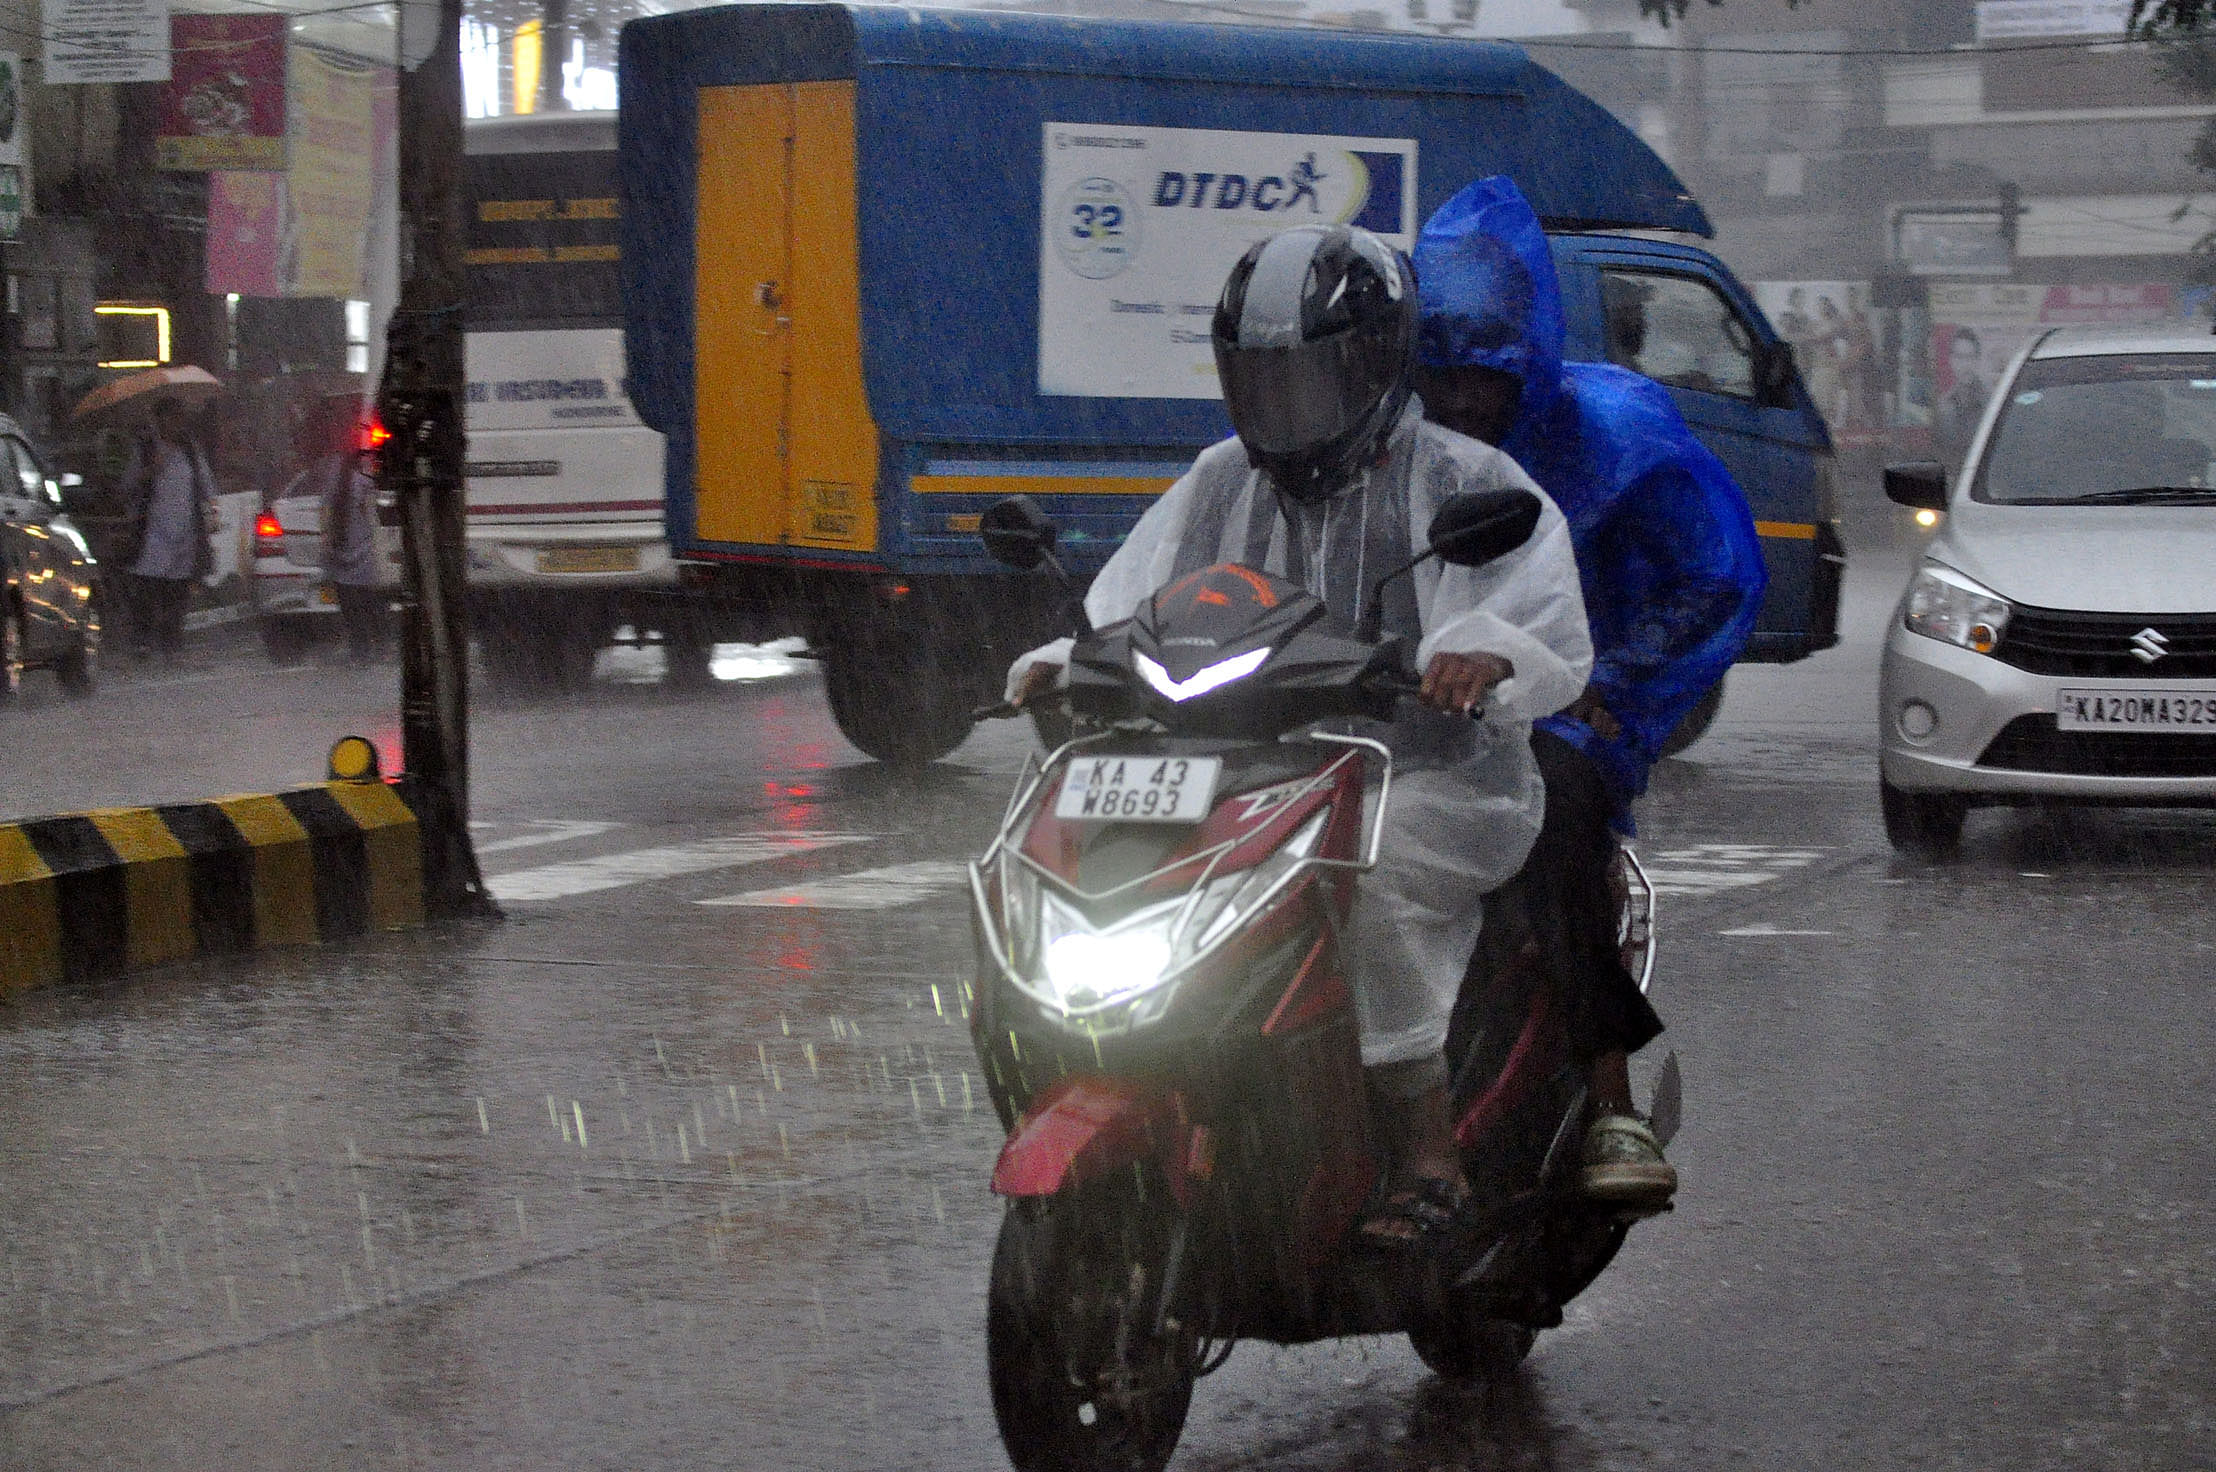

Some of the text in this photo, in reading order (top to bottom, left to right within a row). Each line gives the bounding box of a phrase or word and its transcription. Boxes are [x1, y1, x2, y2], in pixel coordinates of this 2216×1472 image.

[1151, 170, 1284, 211] DTDC
[1072, 204, 1123, 238] 32
[1162, 637, 1217, 647] NDA
[1089, 759, 1189, 786] KA 43
[1081, 789, 1180, 816] W8693
